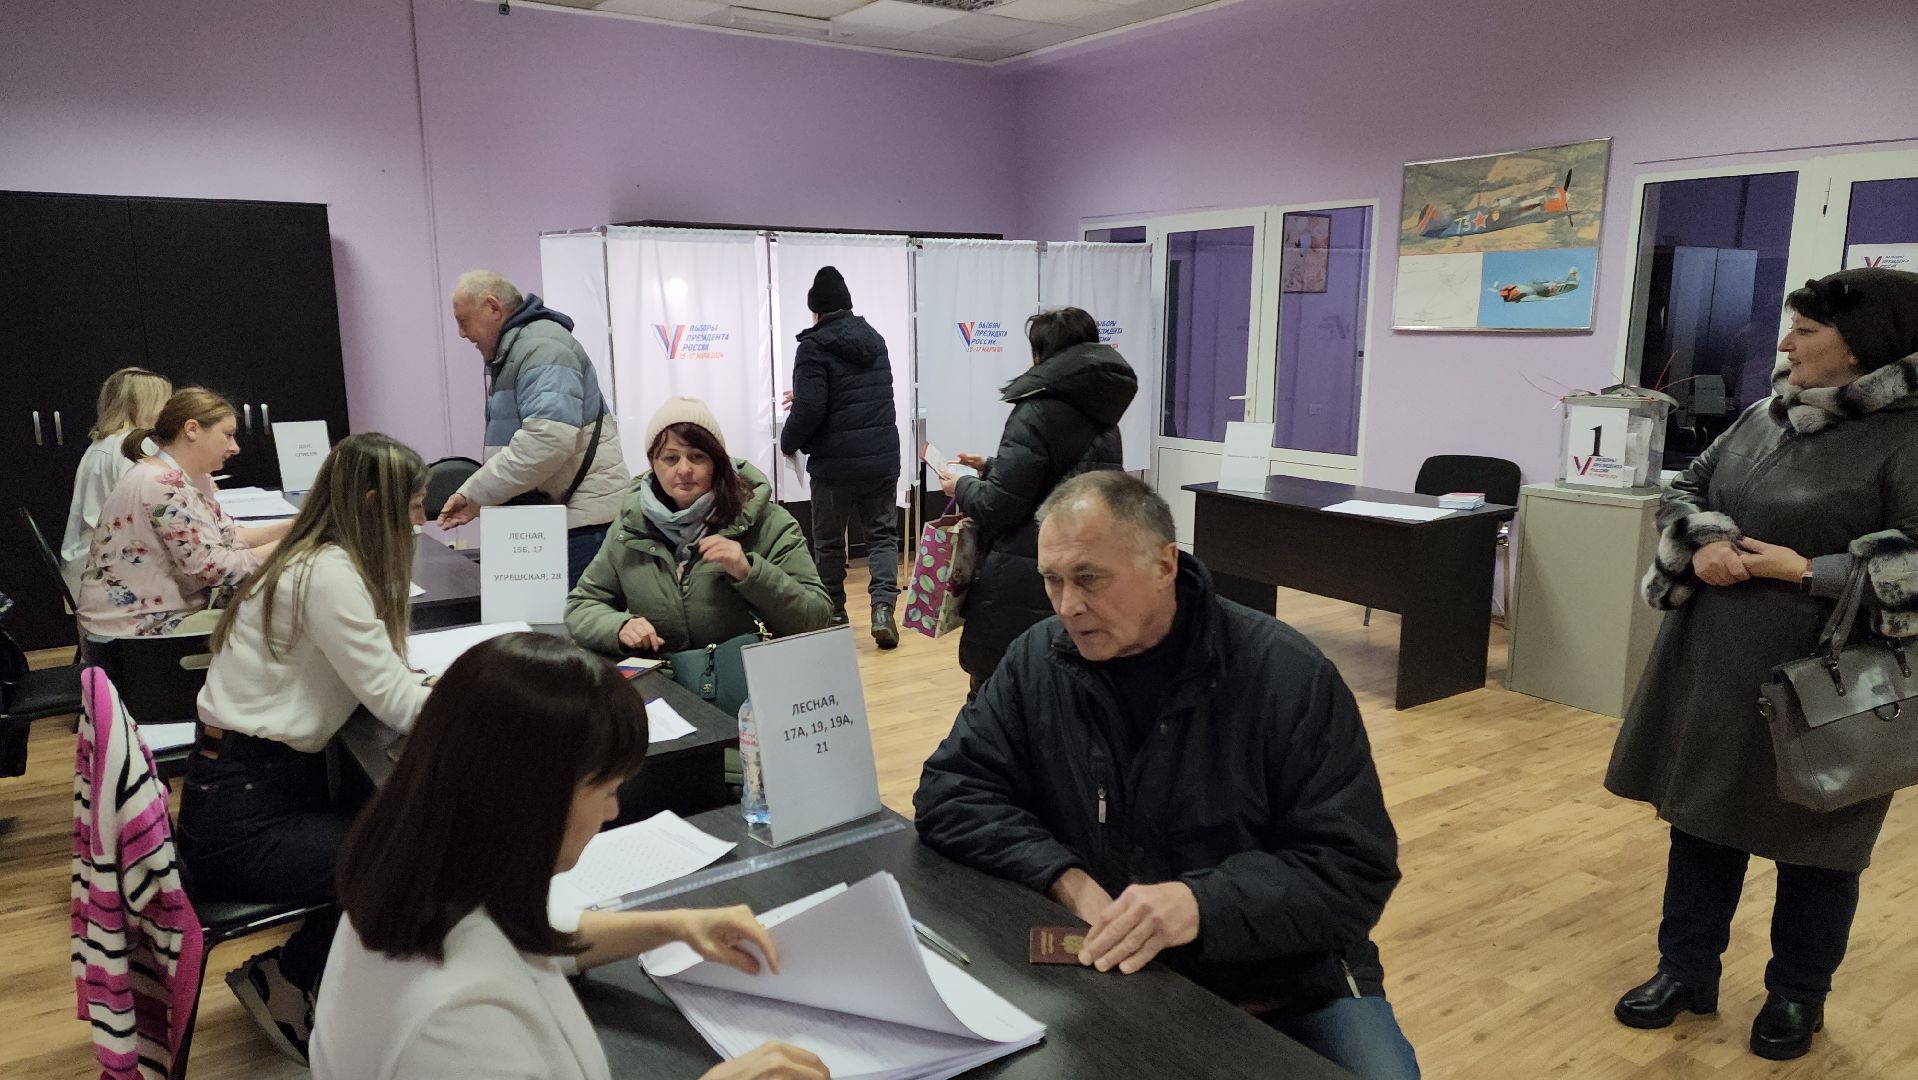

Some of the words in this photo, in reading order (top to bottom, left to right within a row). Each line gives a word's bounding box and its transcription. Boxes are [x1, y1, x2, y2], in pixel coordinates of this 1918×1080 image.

[686, 333, 730, 342] ПРЕЗИДЕНТА
[682, 343, 710, 352] РОССИИ
[1588, 424, 1603, 457] 1
[508, 532, 546, 541] ЛЕСНАЯ,
[533, 545, 543, 553] 17
[494, 573, 549, 581] УГРЕШСКАЯ,
[791, 694, 839, 716] ЛЕСНАЯ,
[784, 726, 808, 741] 17А,
[811, 720, 828, 735] 19,
[830, 714, 854, 729] 19А,
[816, 741, 828, 754] 21
